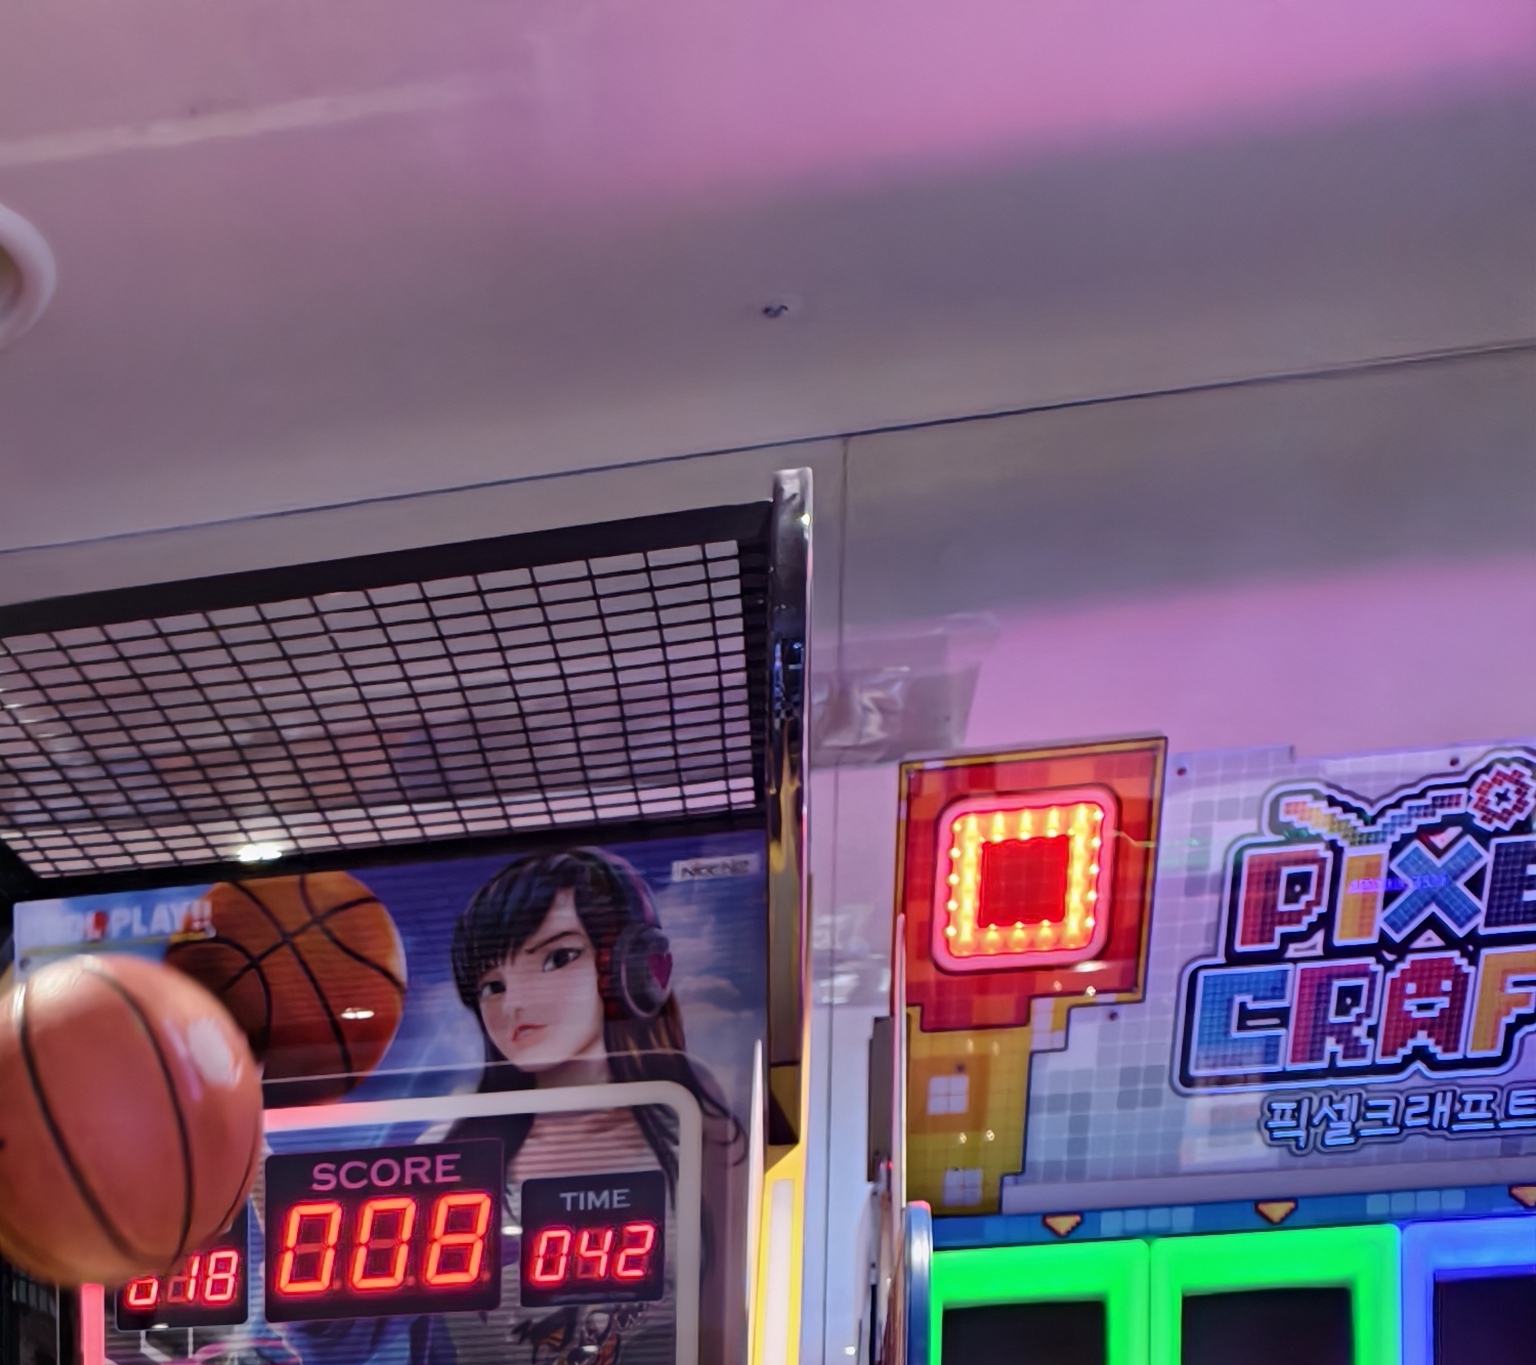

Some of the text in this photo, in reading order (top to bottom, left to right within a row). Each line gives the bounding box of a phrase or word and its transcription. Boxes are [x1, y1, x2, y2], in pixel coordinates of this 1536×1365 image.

[312, 1153, 461, 1192] SCORE
[559, 1188, 631, 1212] TIME
[276, 1191, 491, 1295] 008
[533, 1222, 655, 1283] 042
